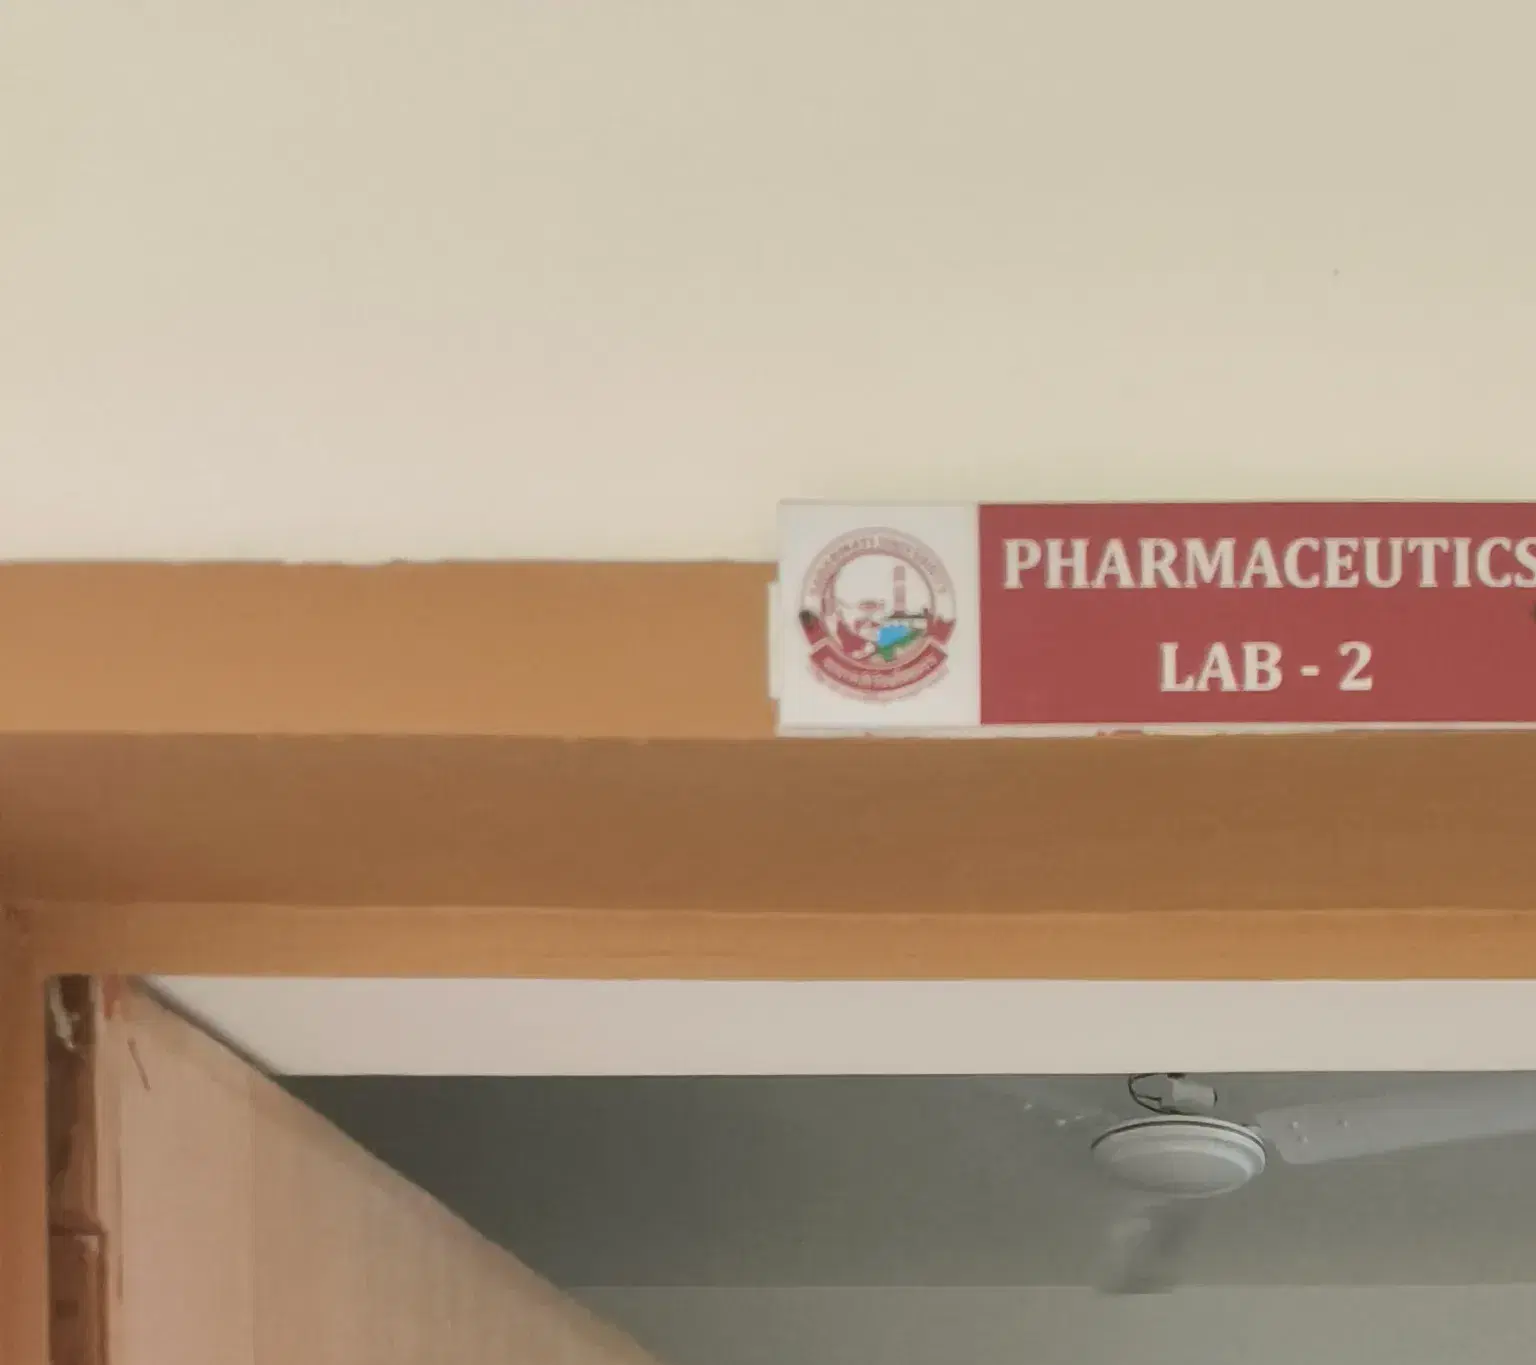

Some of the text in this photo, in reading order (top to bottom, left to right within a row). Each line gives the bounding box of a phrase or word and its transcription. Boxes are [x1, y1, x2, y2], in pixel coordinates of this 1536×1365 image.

[1159, 641, 1373, 692] LAB - 2
